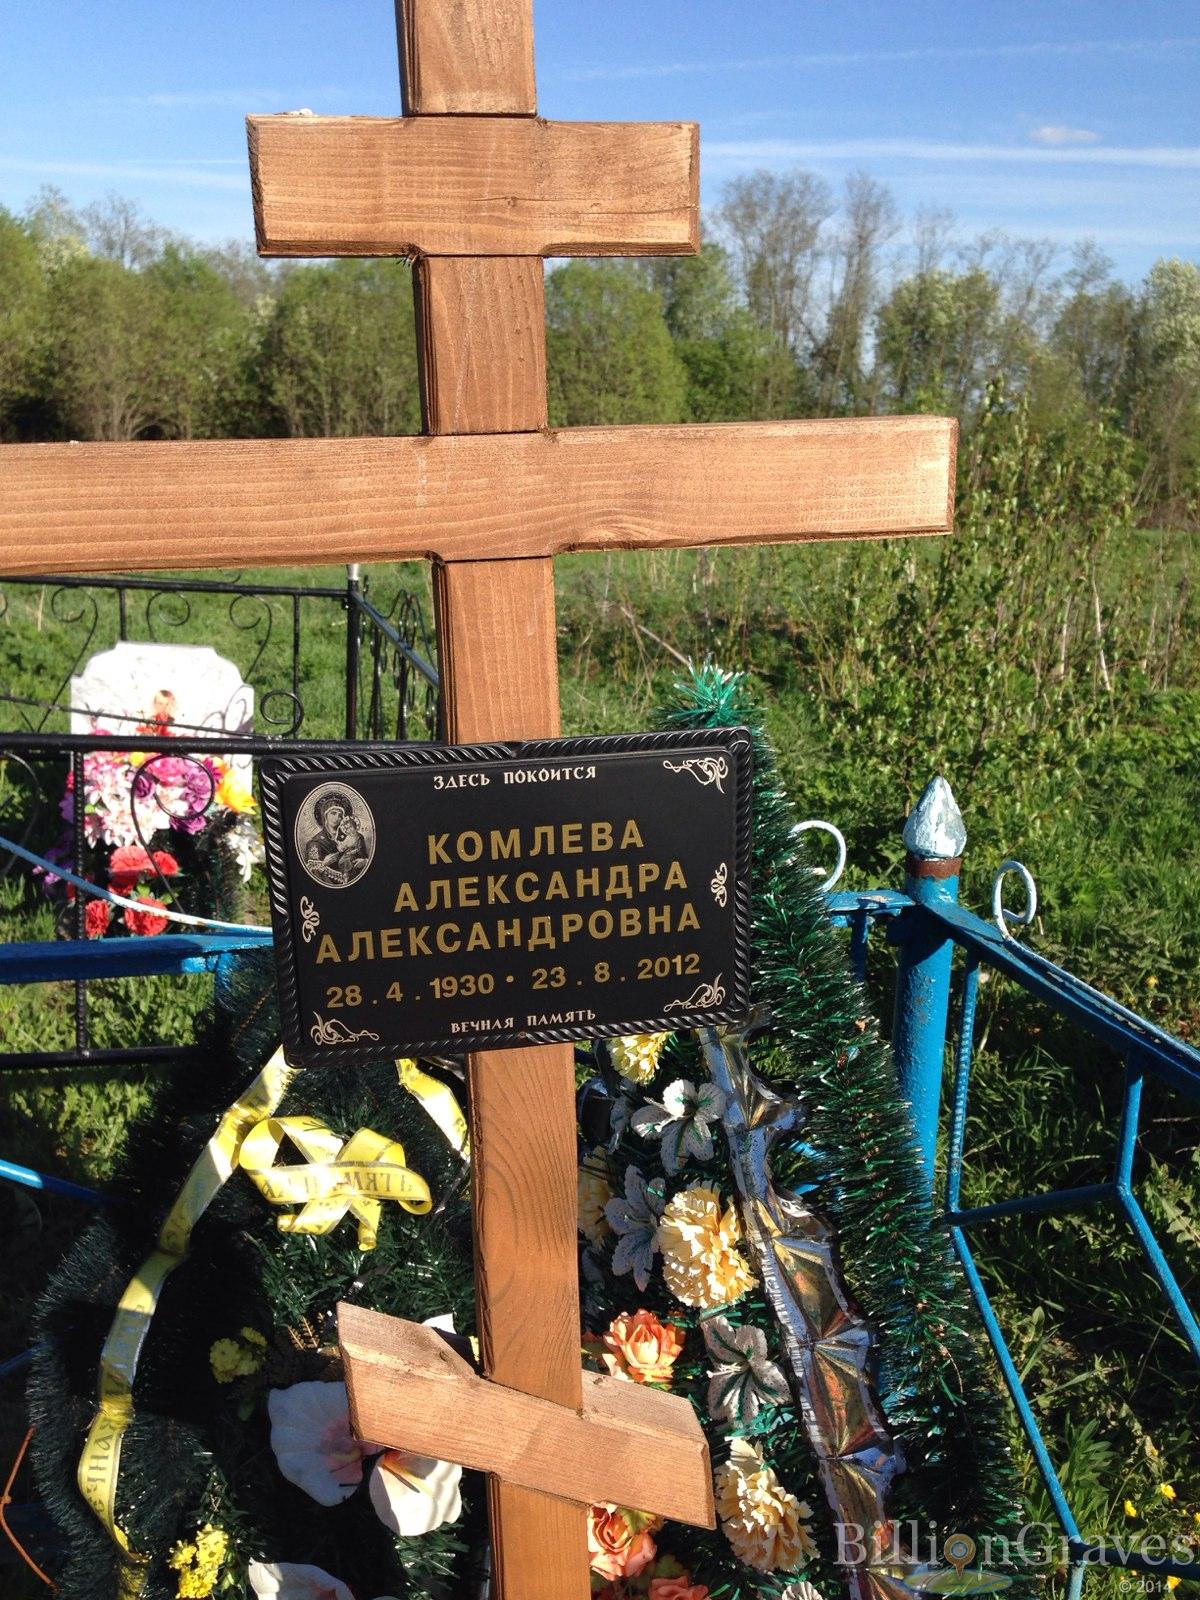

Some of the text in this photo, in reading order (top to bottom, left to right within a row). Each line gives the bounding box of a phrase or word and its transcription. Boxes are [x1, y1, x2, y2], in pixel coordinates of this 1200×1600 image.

[433, 765, 597, 790] ЗДЕСЬ ПОКОИТСЯ
[427, 819, 645, 865] КОМЛЕВА
[393, 860, 688, 913] АЛЕКСАНДРА
[316, 902, 701, 964] АЛЕКСАНДРОВНА
[450, 1009, 596, 1034] ВЕЧНАЯ ПАМЯТЬ
